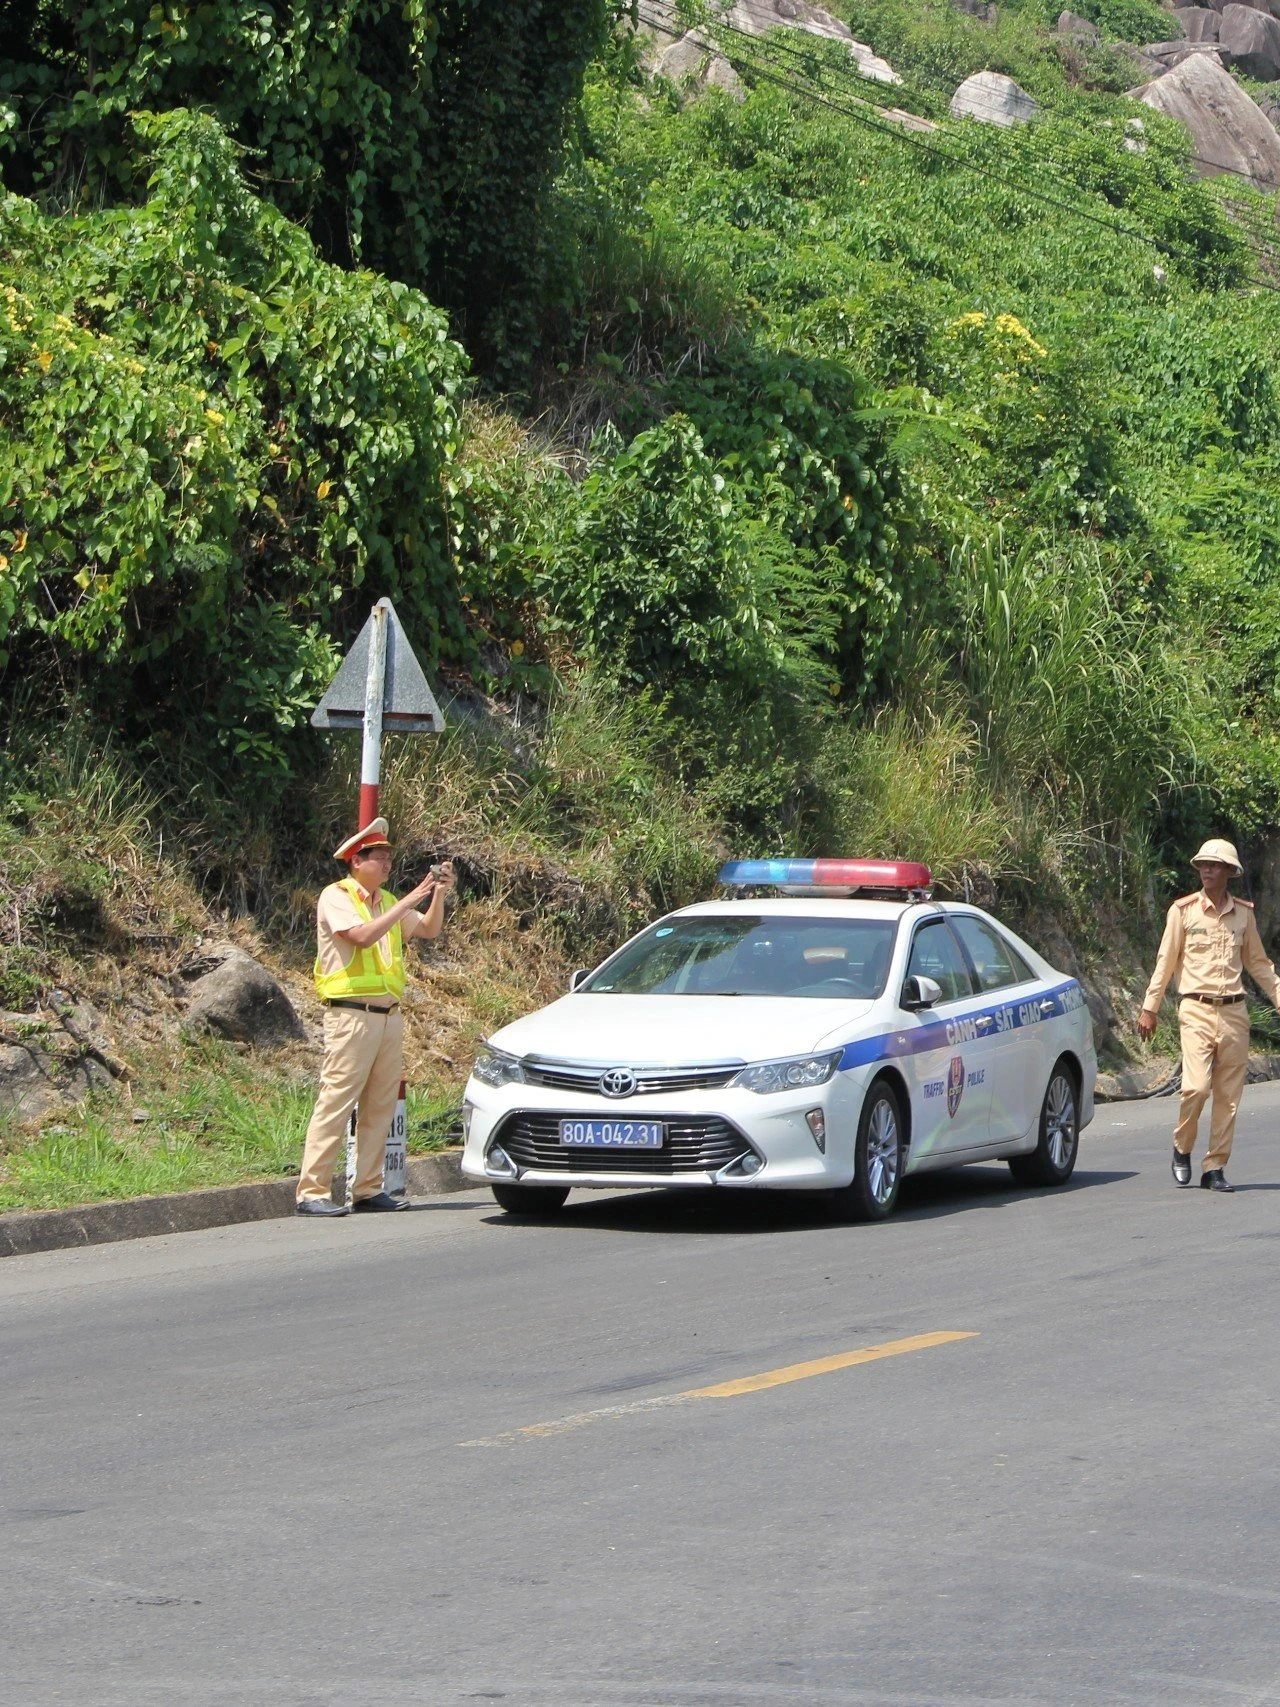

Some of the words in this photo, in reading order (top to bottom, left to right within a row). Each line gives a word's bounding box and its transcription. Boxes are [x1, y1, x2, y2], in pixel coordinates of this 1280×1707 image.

[946, 1017, 978, 1045] CẢNH
[995, 1005, 1014, 1032] SÁT
[1018, 1001, 1042, 1026] GIAO
[923, 1080, 945, 1099] TRAFFIC
[967, 1068, 985, 1088] POLICE
[563, 1123, 658, 1145] 80A-042.31
